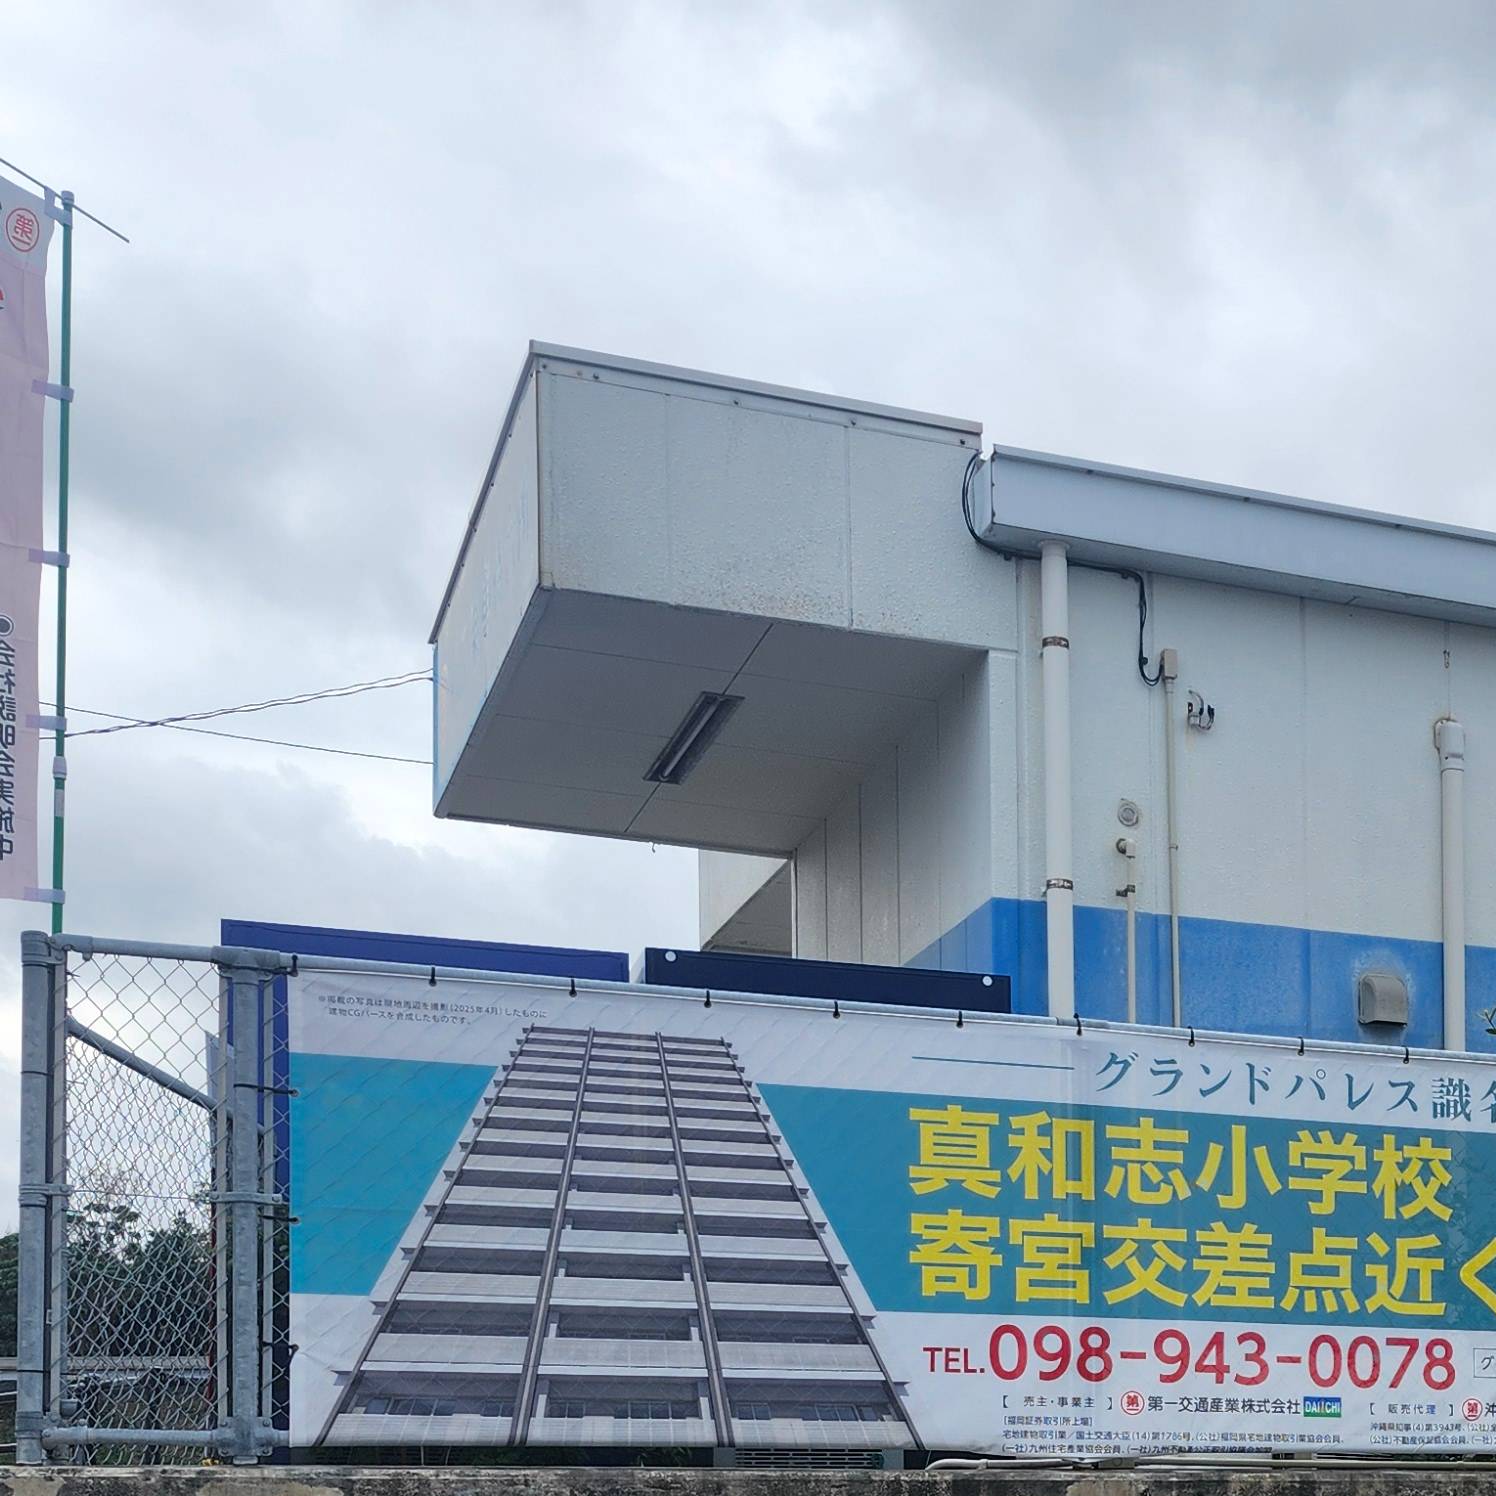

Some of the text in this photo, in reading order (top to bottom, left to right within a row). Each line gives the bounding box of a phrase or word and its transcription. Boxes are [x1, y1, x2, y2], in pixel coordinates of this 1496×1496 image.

[907, 1103, 1453, 1222] 真和志小学校
[922, 1322, 1457, 1391] TEL. 098-943-0078
[1147, 1395, 1301, 1415] 第一交通産業株式会社
